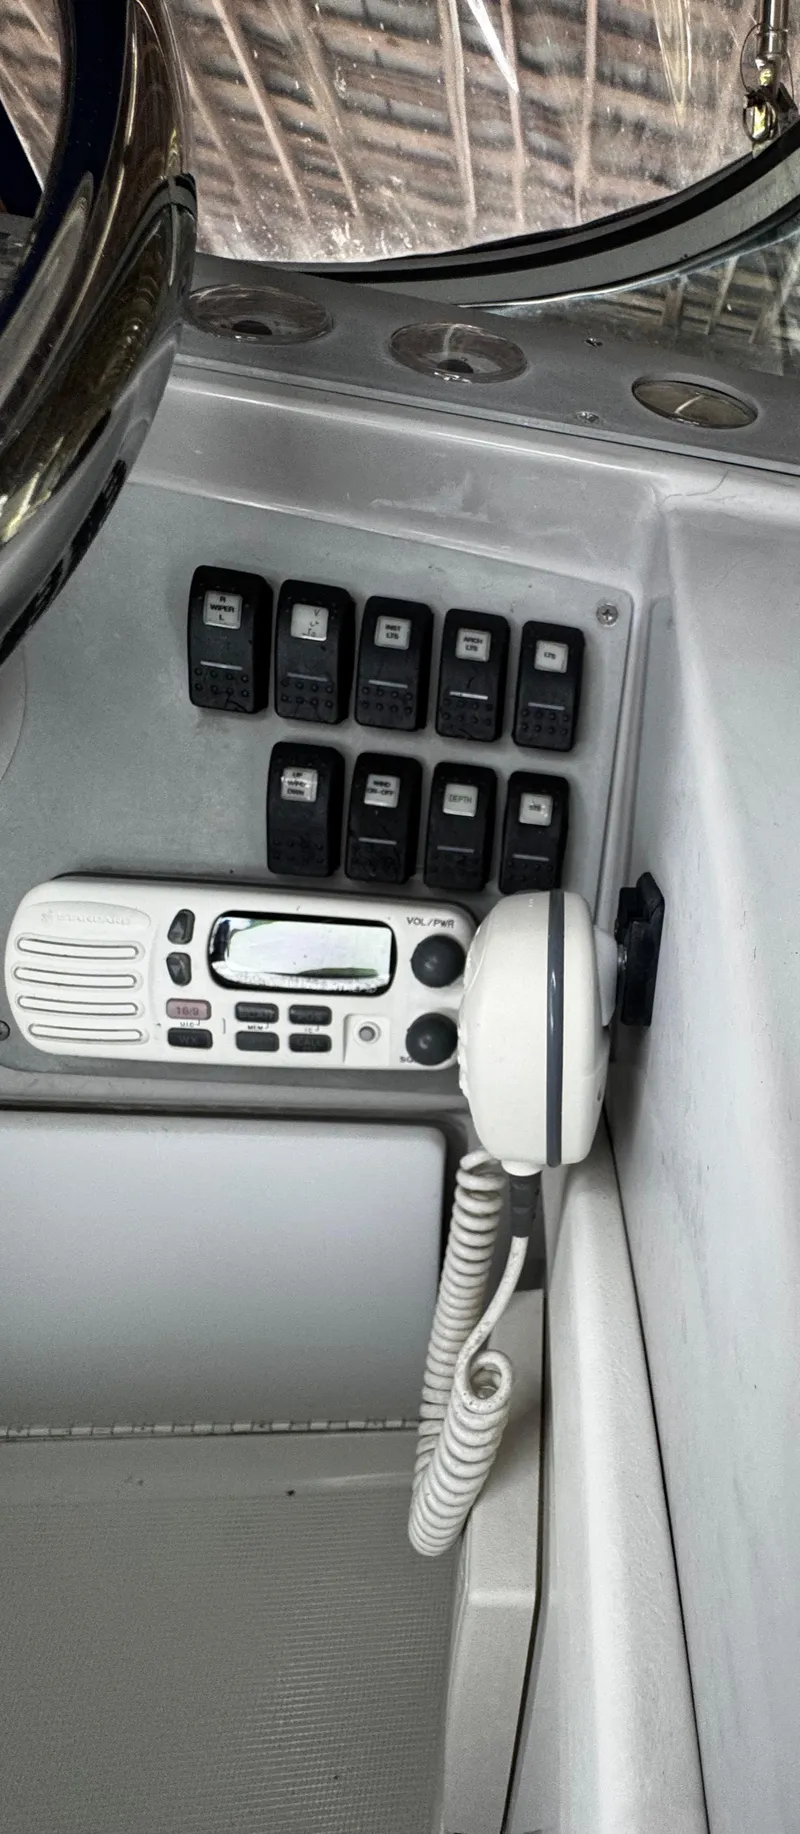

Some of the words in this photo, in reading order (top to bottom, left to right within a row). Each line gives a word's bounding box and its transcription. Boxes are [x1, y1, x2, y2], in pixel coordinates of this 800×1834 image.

[209, 603, 235, 613] WIPER
[448, 794, 473, 804] DEPTH
[406, 916, 455, 929] VOL/PWR
